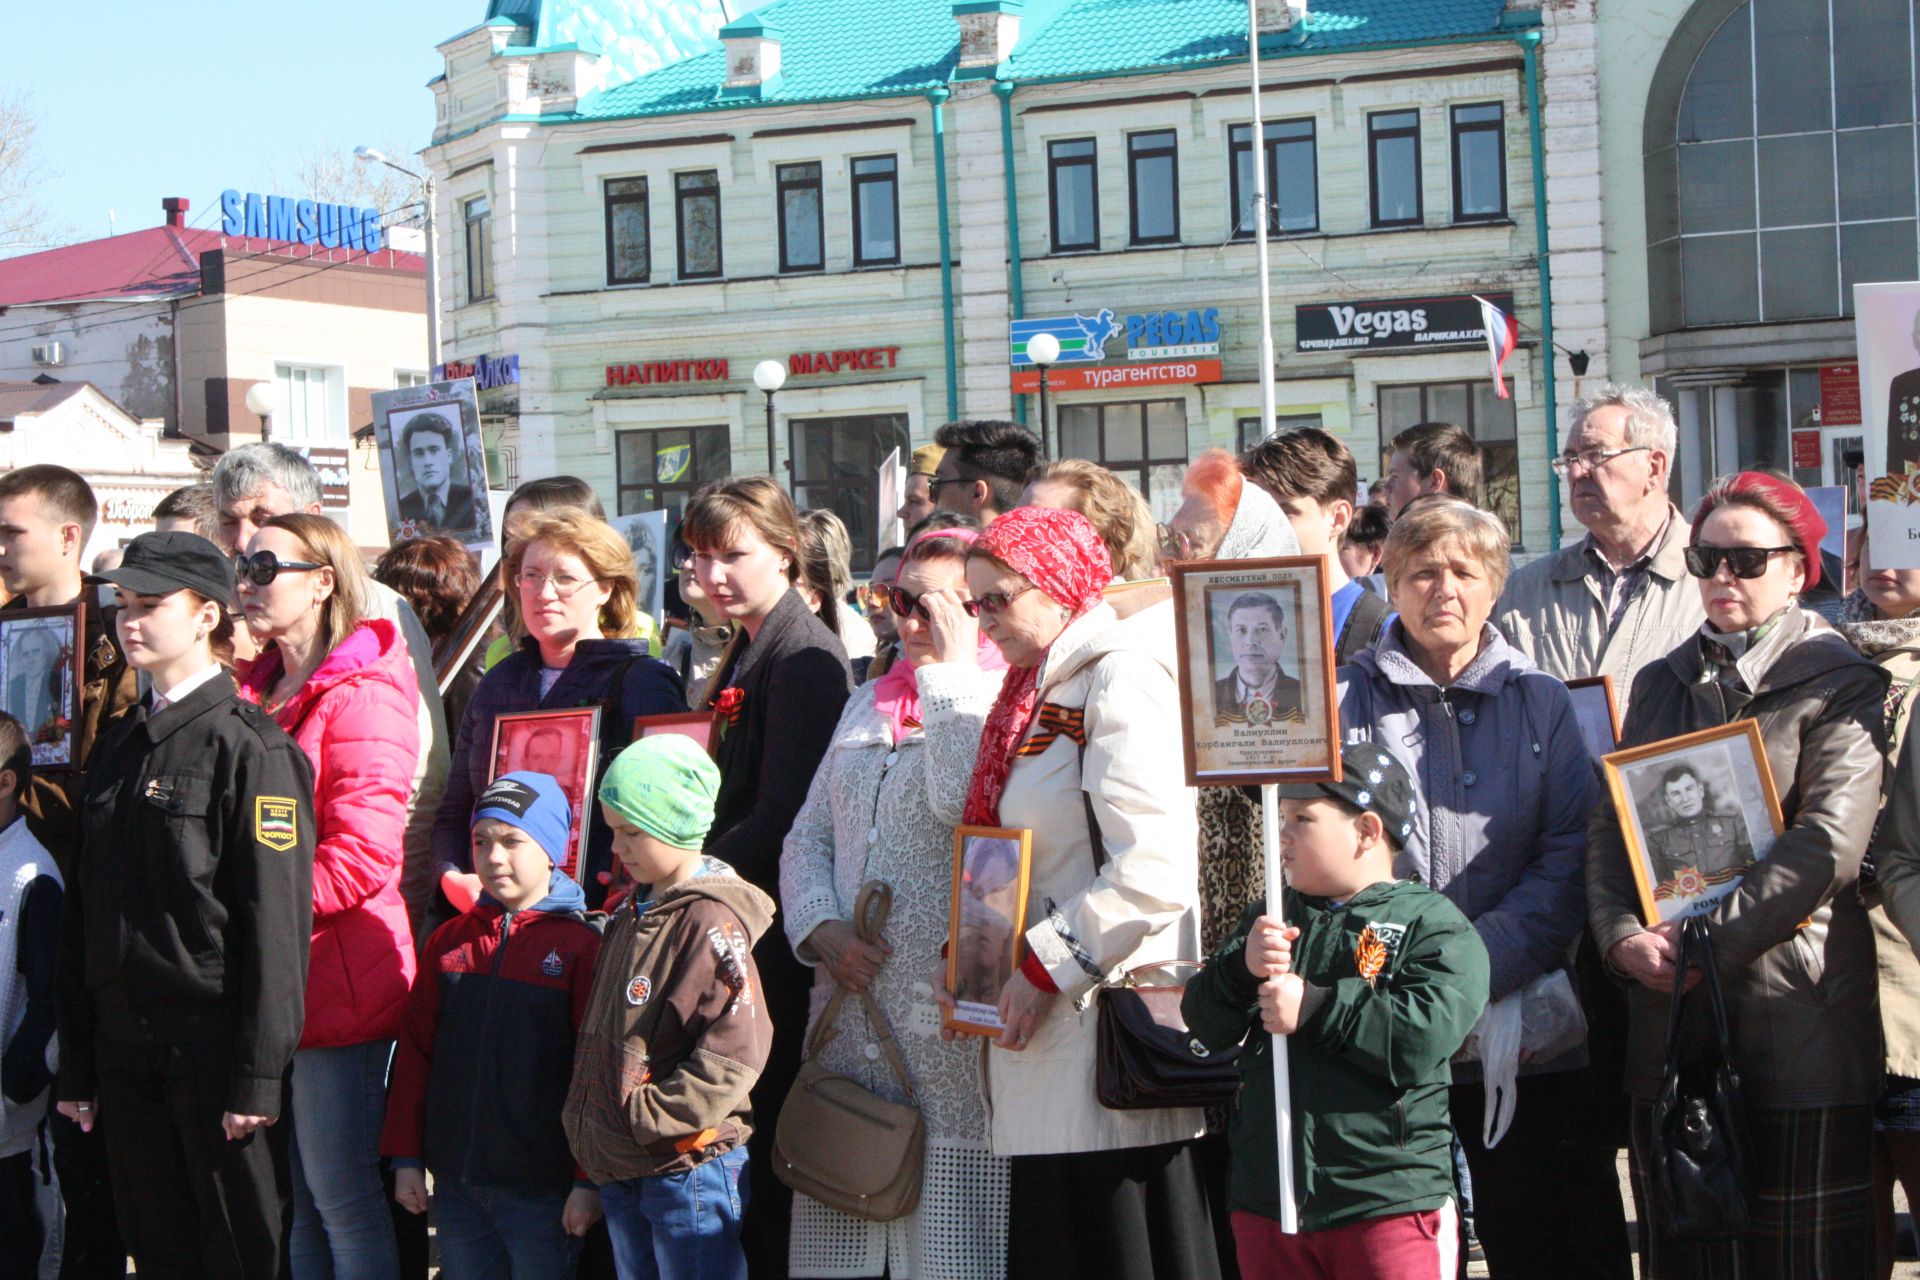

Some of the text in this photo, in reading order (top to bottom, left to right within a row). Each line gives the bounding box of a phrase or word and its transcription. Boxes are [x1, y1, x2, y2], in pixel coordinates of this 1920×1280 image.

[221, 189, 382, 254] SAMSUNG
[1127, 307, 1220, 349] PEGAS
[1328, 306, 1428, 338] Vegas
[788, 345, 901, 377] МАРКЕТ
[1129, 345, 1219, 359] TOURISTIK
[606, 358, 729, 387] НАПИТКИ
[1084, 364, 1197, 387] турагентство
[1209, 574, 1267, 583] БЕССМЕРТНЫЙ
[1233, 729, 1288, 737] Валиуллин
